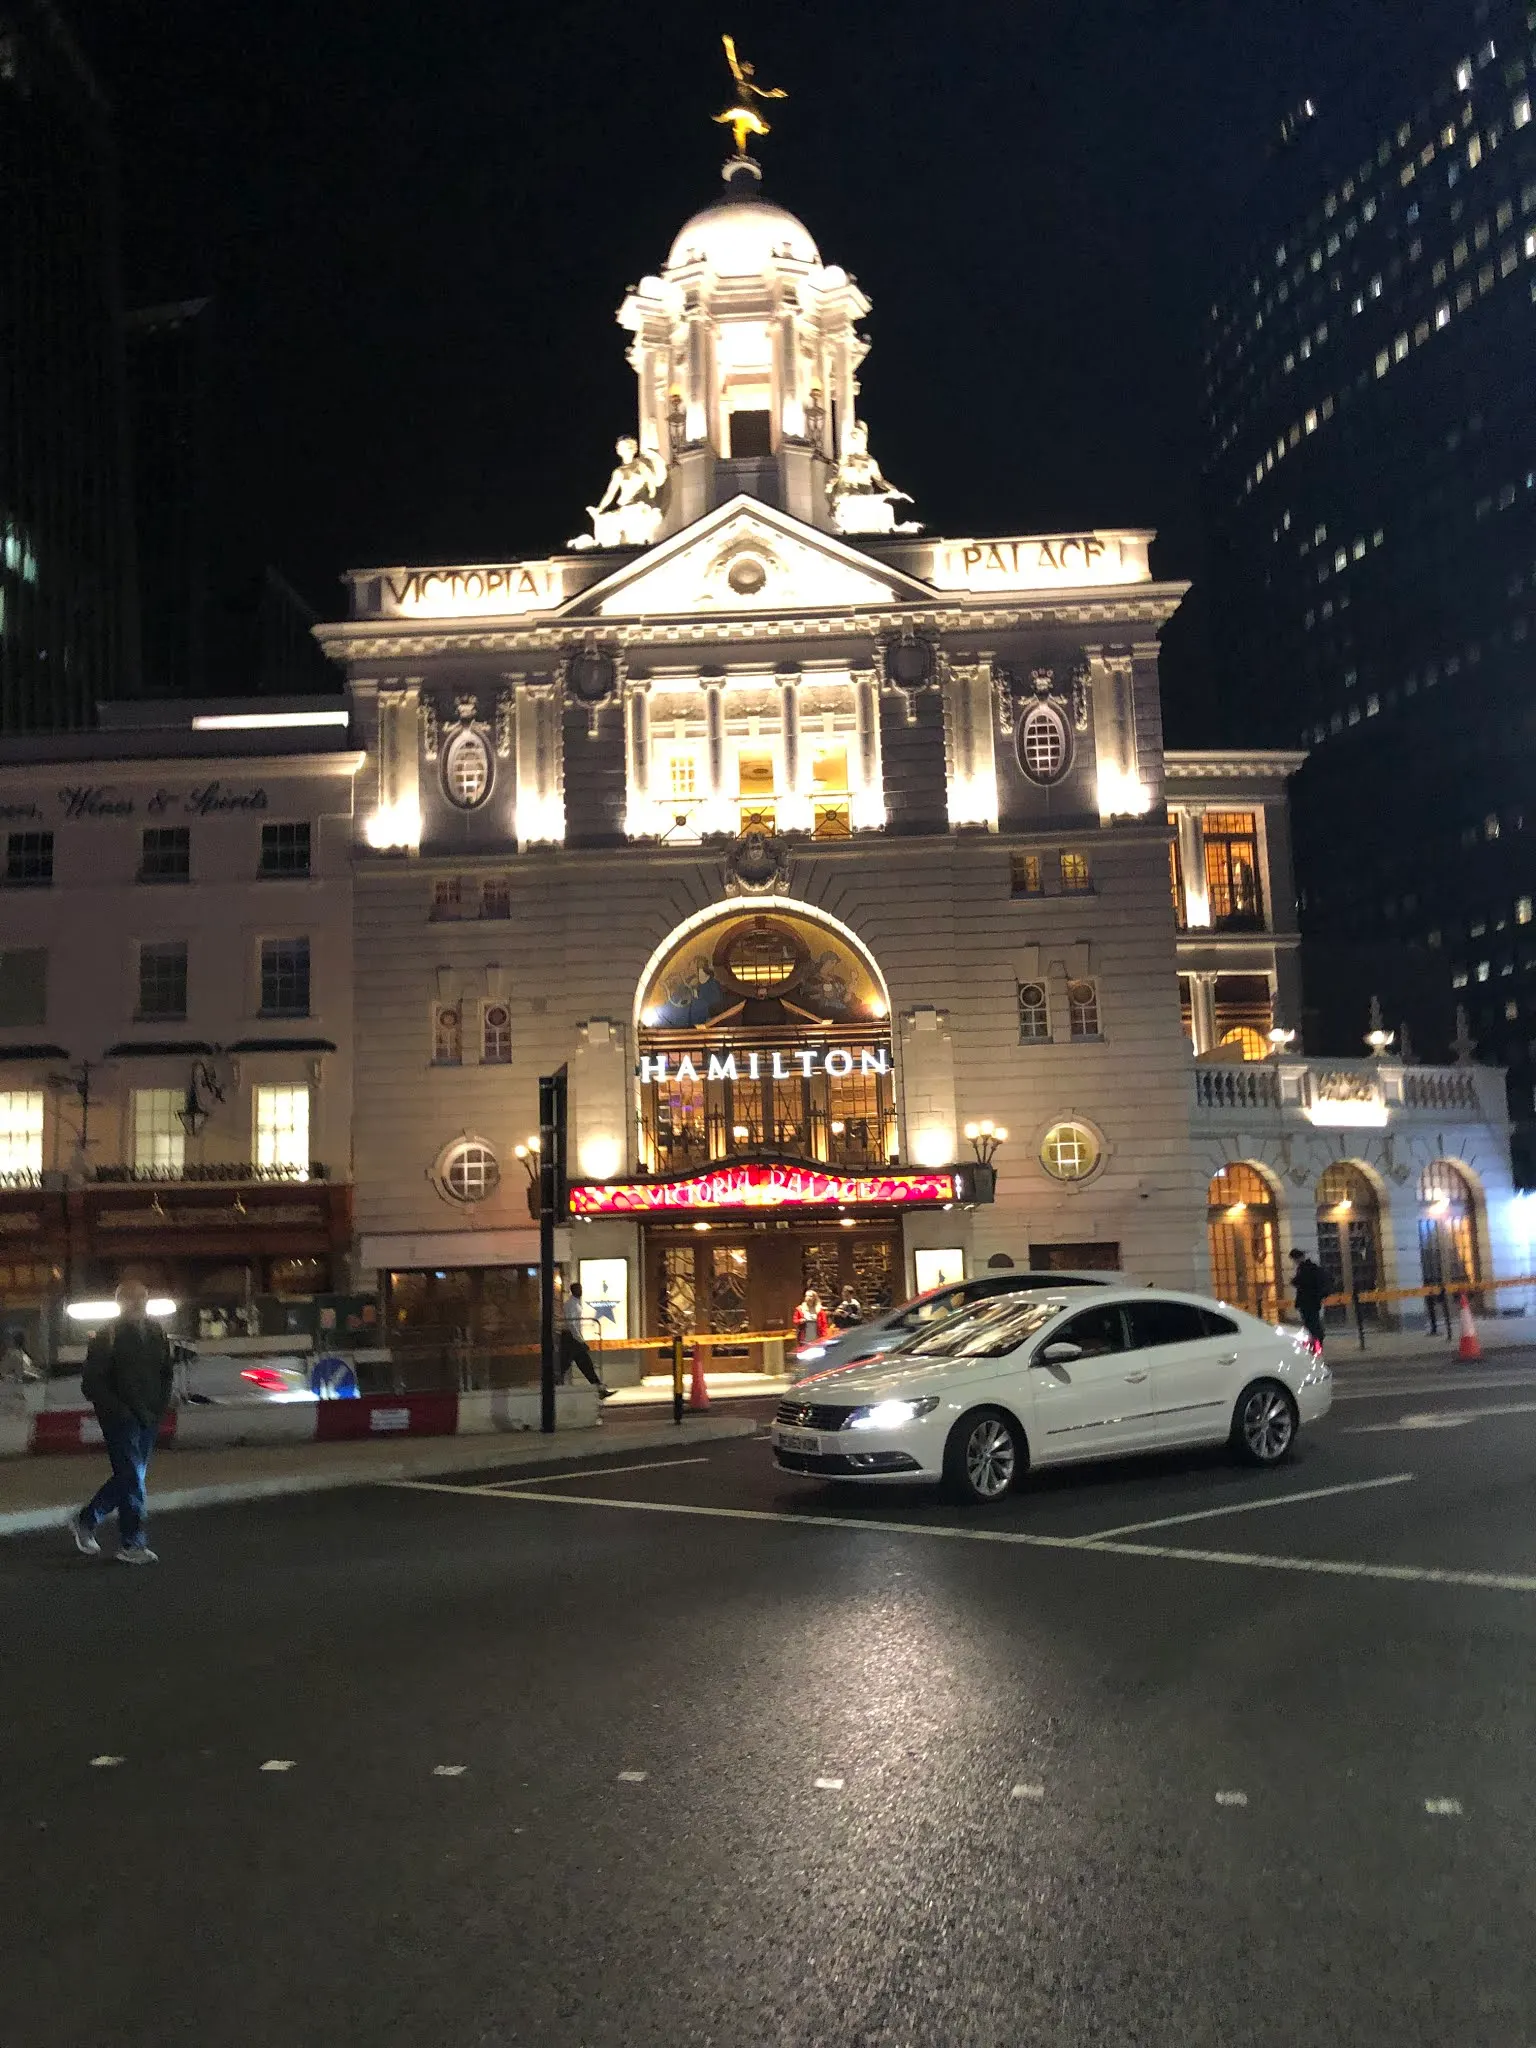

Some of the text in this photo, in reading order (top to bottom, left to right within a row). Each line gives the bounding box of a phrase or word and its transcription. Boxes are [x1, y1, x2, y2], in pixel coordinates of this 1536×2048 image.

[384, 568, 539, 605] VICTORIA
[640, 1048, 890, 1084] HAMILTON
[646, 1170, 878, 1206] VICTORIA PALACE
